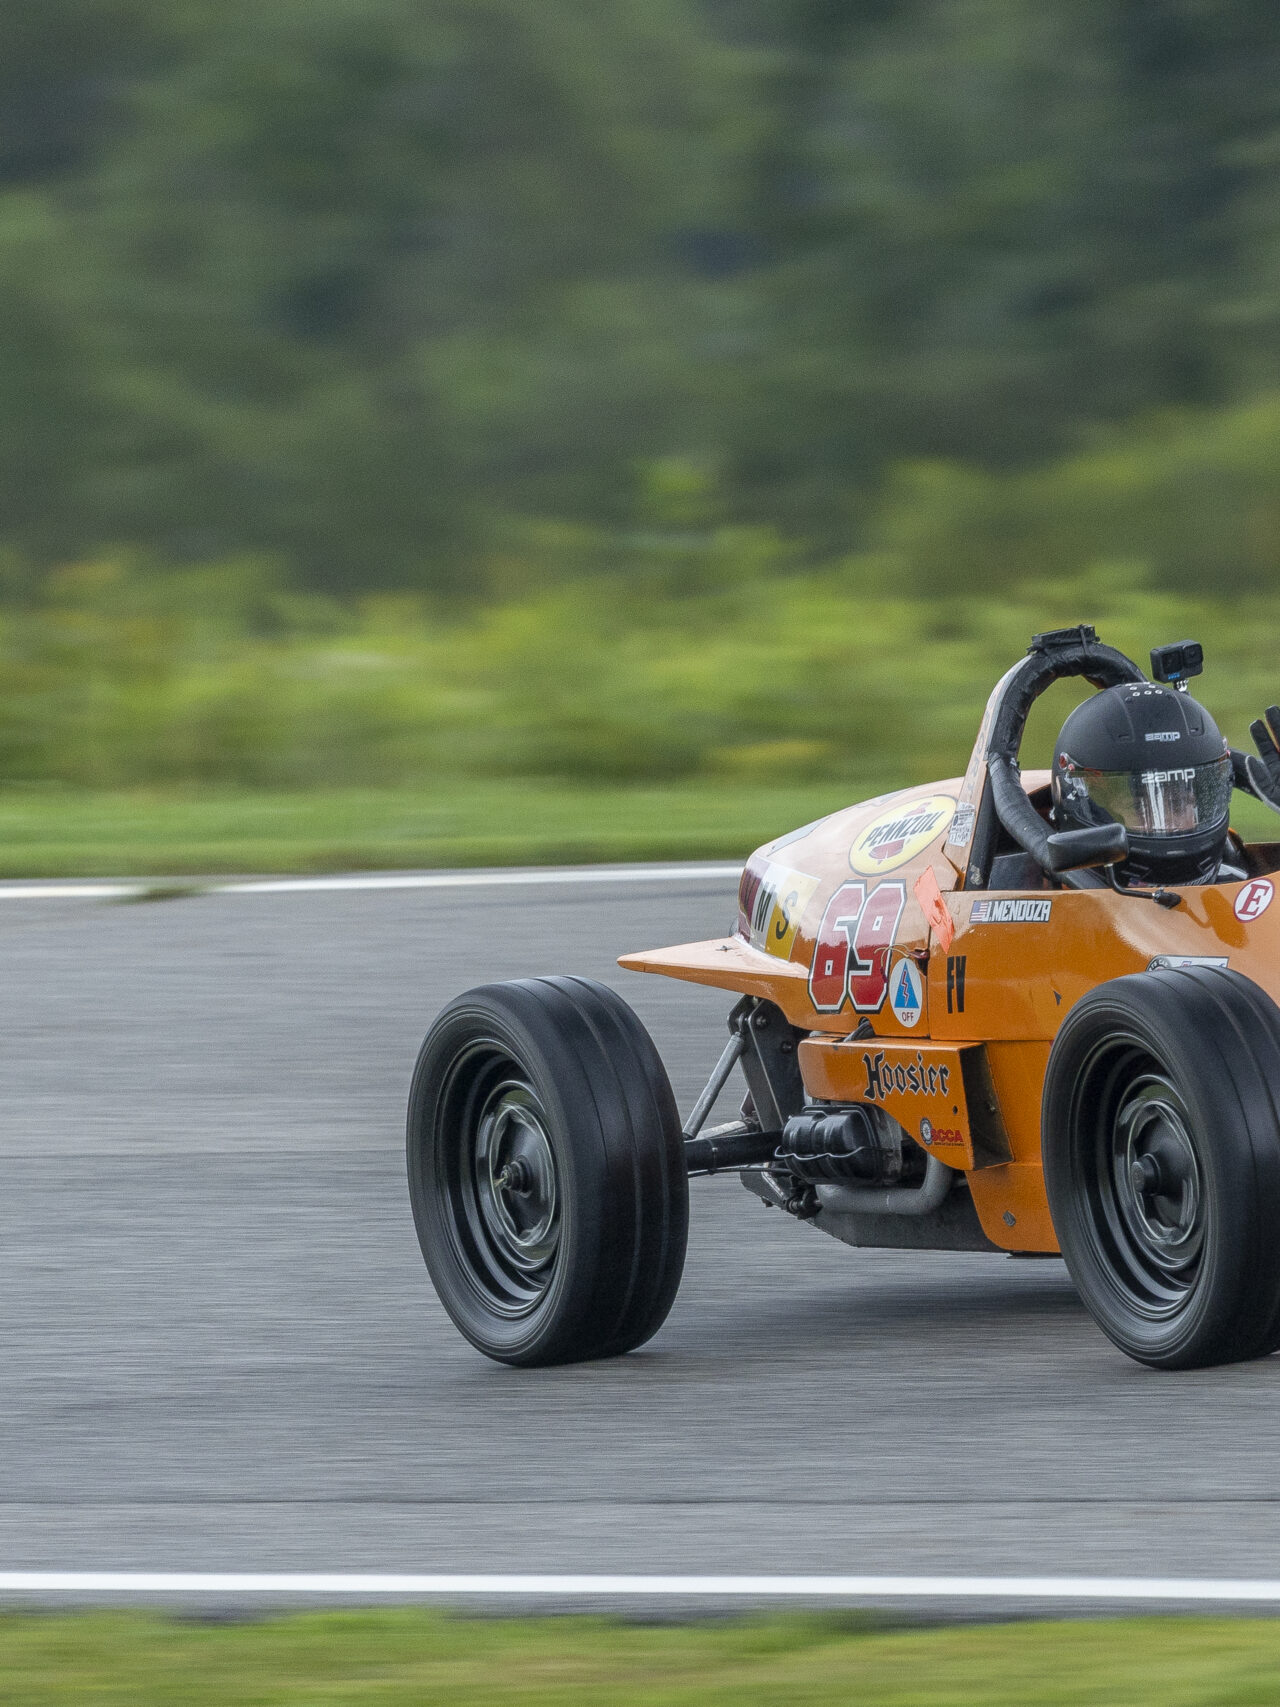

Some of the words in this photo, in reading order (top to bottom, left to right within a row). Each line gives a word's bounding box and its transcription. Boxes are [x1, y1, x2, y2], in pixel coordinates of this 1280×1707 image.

[1145, 732, 1181, 742] zamp
[1141, 768, 1196, 784] zamp
[858, 811, 945, 852] PENNZOIL
[981, 900, 1052, 921] J.MENDOZA
[1238, 884, 1270, 916] E
[808, 879, 907, 1014] 69
[947, 955, 966, 1014] FV
[901, 1011, 914, 1022] OFF
[862, 1050, 950, 1101] Hoosier
[930, 1129, 964, 1142] SCCA
